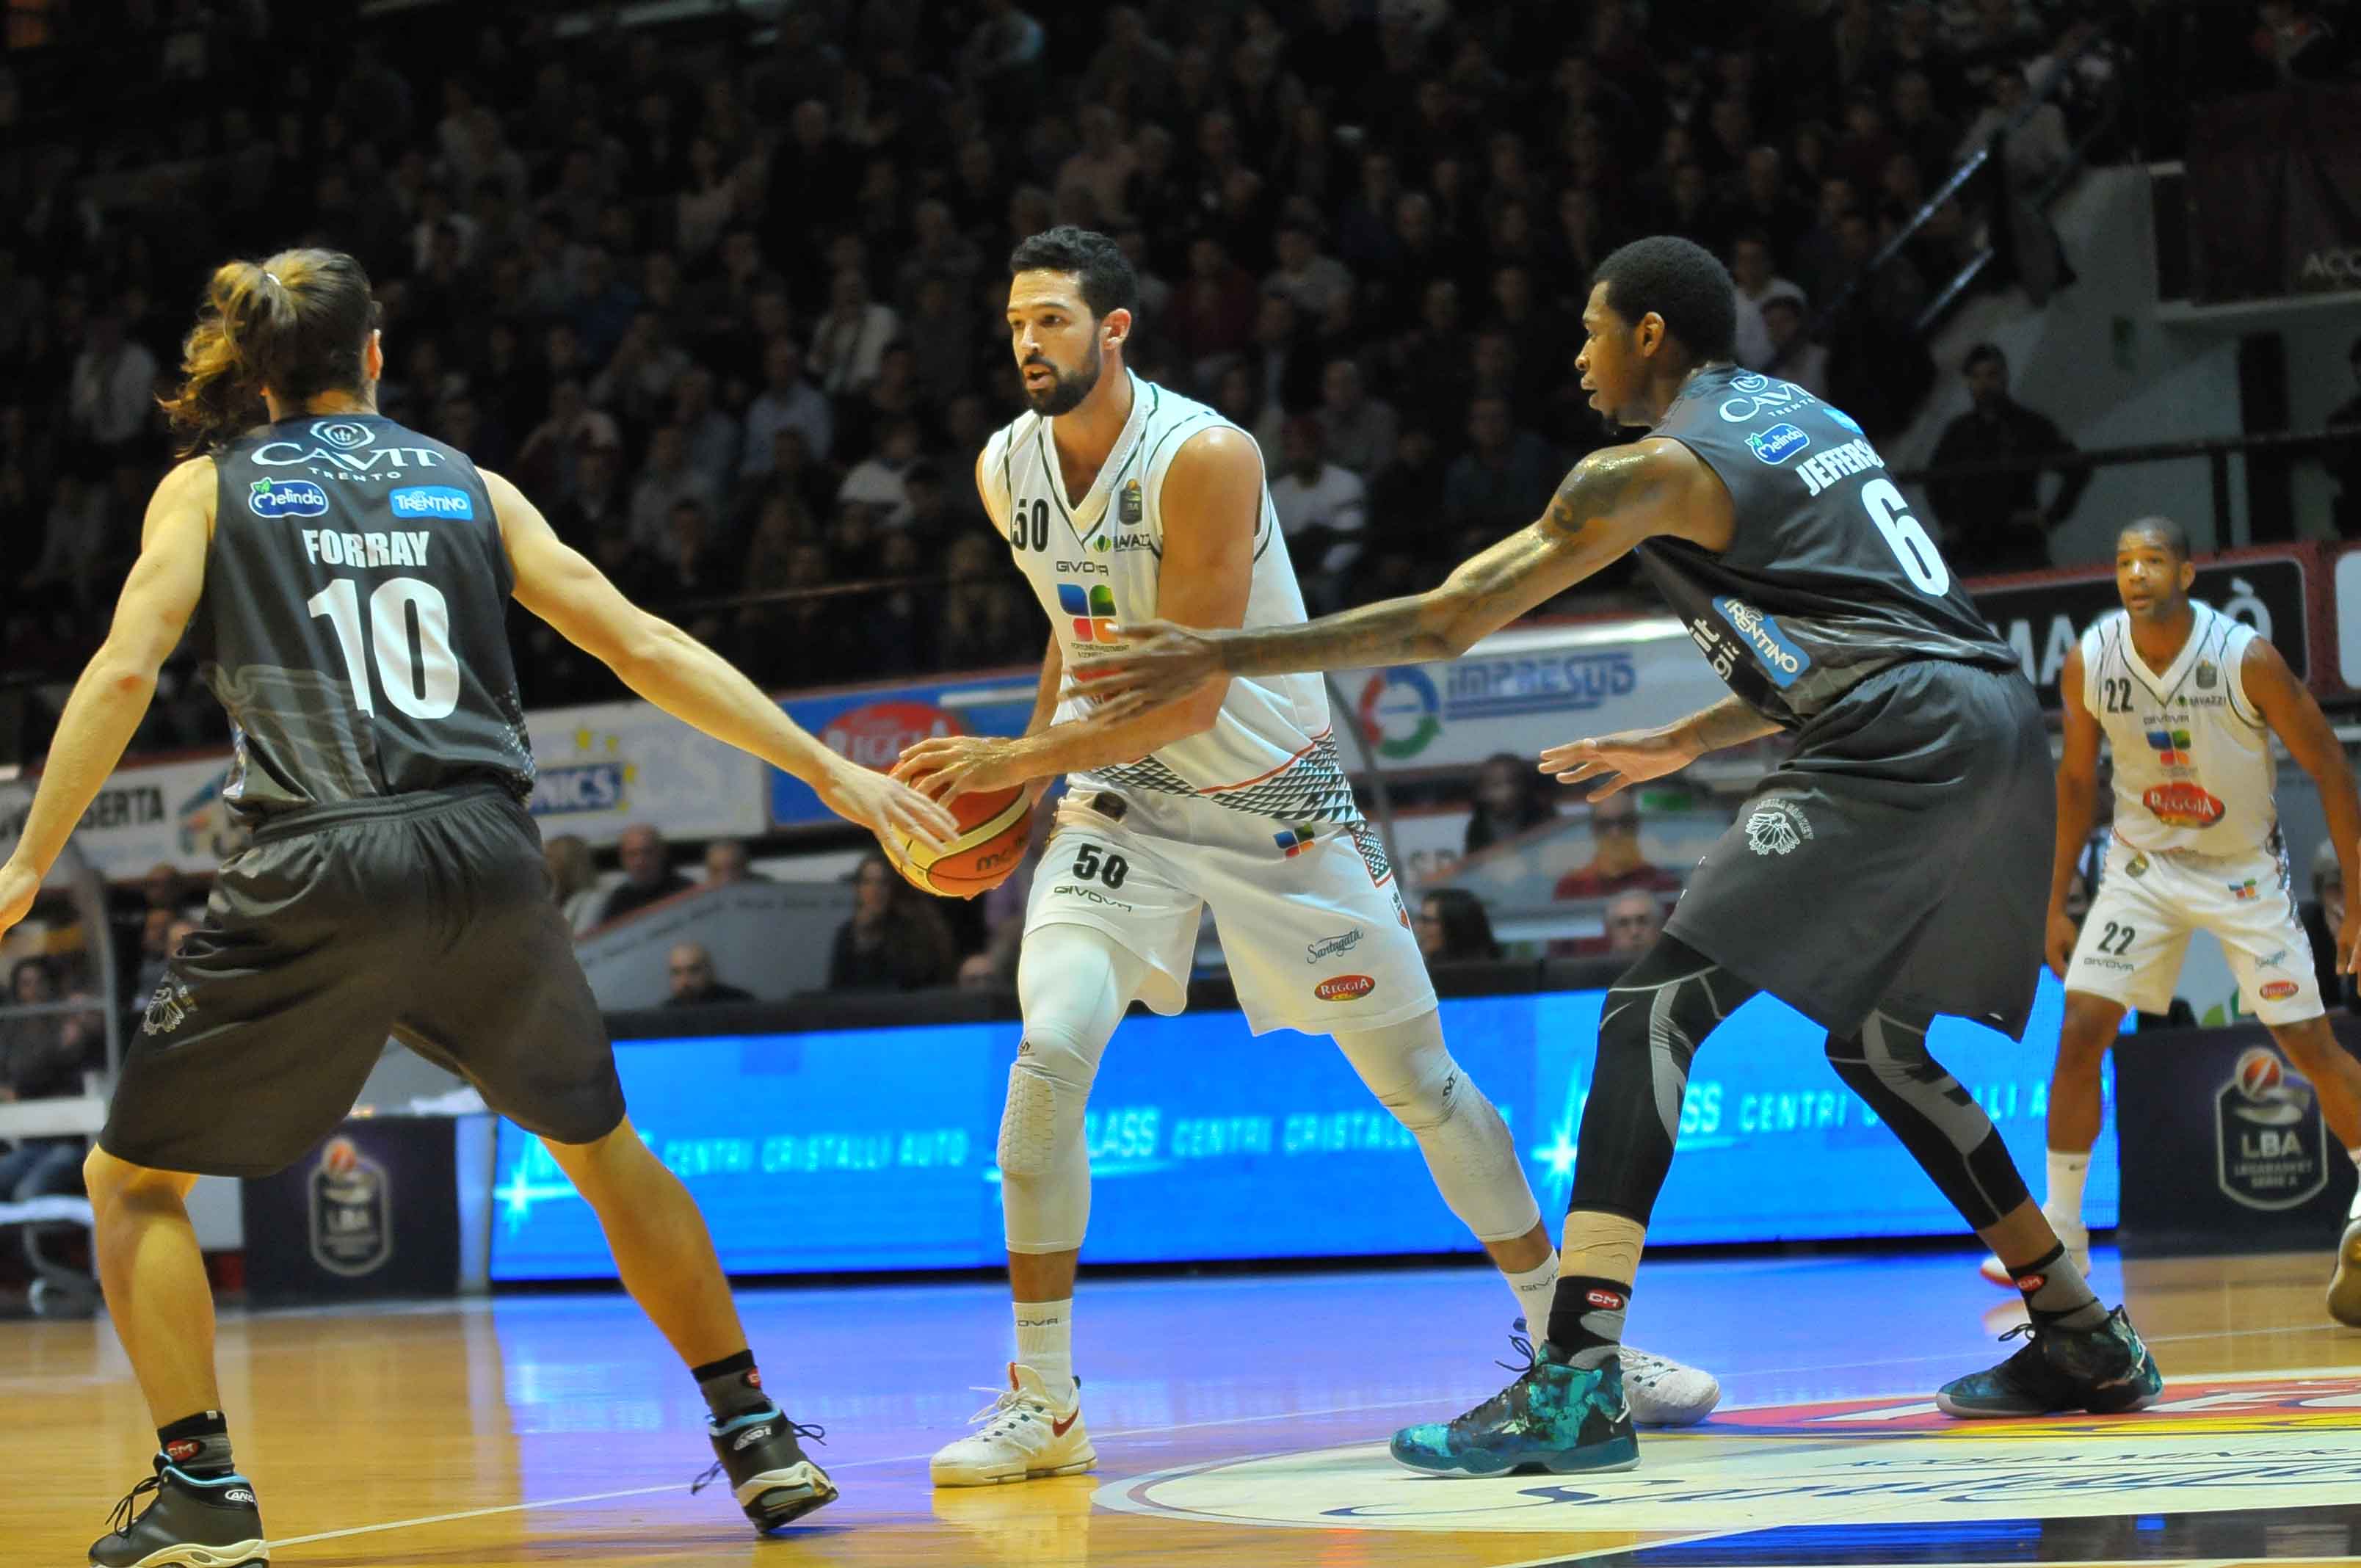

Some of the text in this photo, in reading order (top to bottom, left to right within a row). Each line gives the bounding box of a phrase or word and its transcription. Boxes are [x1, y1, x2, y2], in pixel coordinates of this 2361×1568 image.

[250, 442, 446, 472] CAVIT
[1757, 427, 1804, 459] Melinda
[308, 466, 402, 482] TRENTO
[1795, 438, 1885, 497] JEFFERS
[254, 487, 324, 509] Melinda
[394, 493, 468, 511] TRENTINO
[1012, 498, 1050, 552] 50
[1861, 478, 1950, 597] 6
[302, 529, 430, 568] FORRAY
[307, 577, 460, 719] 10
[2105, 677, 2134, 714] 22
[1072, 843, 1130, 890] 50
[1053, 885, 1132, 912] GIVOVA
[2097, 921, 2136, 956] 22
[1321, 977, 1369, 995] REGGIA
[1740, 1092, 1848, 1132] CENTRI
[1172, 1115, 1274, 1156] CENTRI
[2241, 1130, 2302, 1159] LBA
